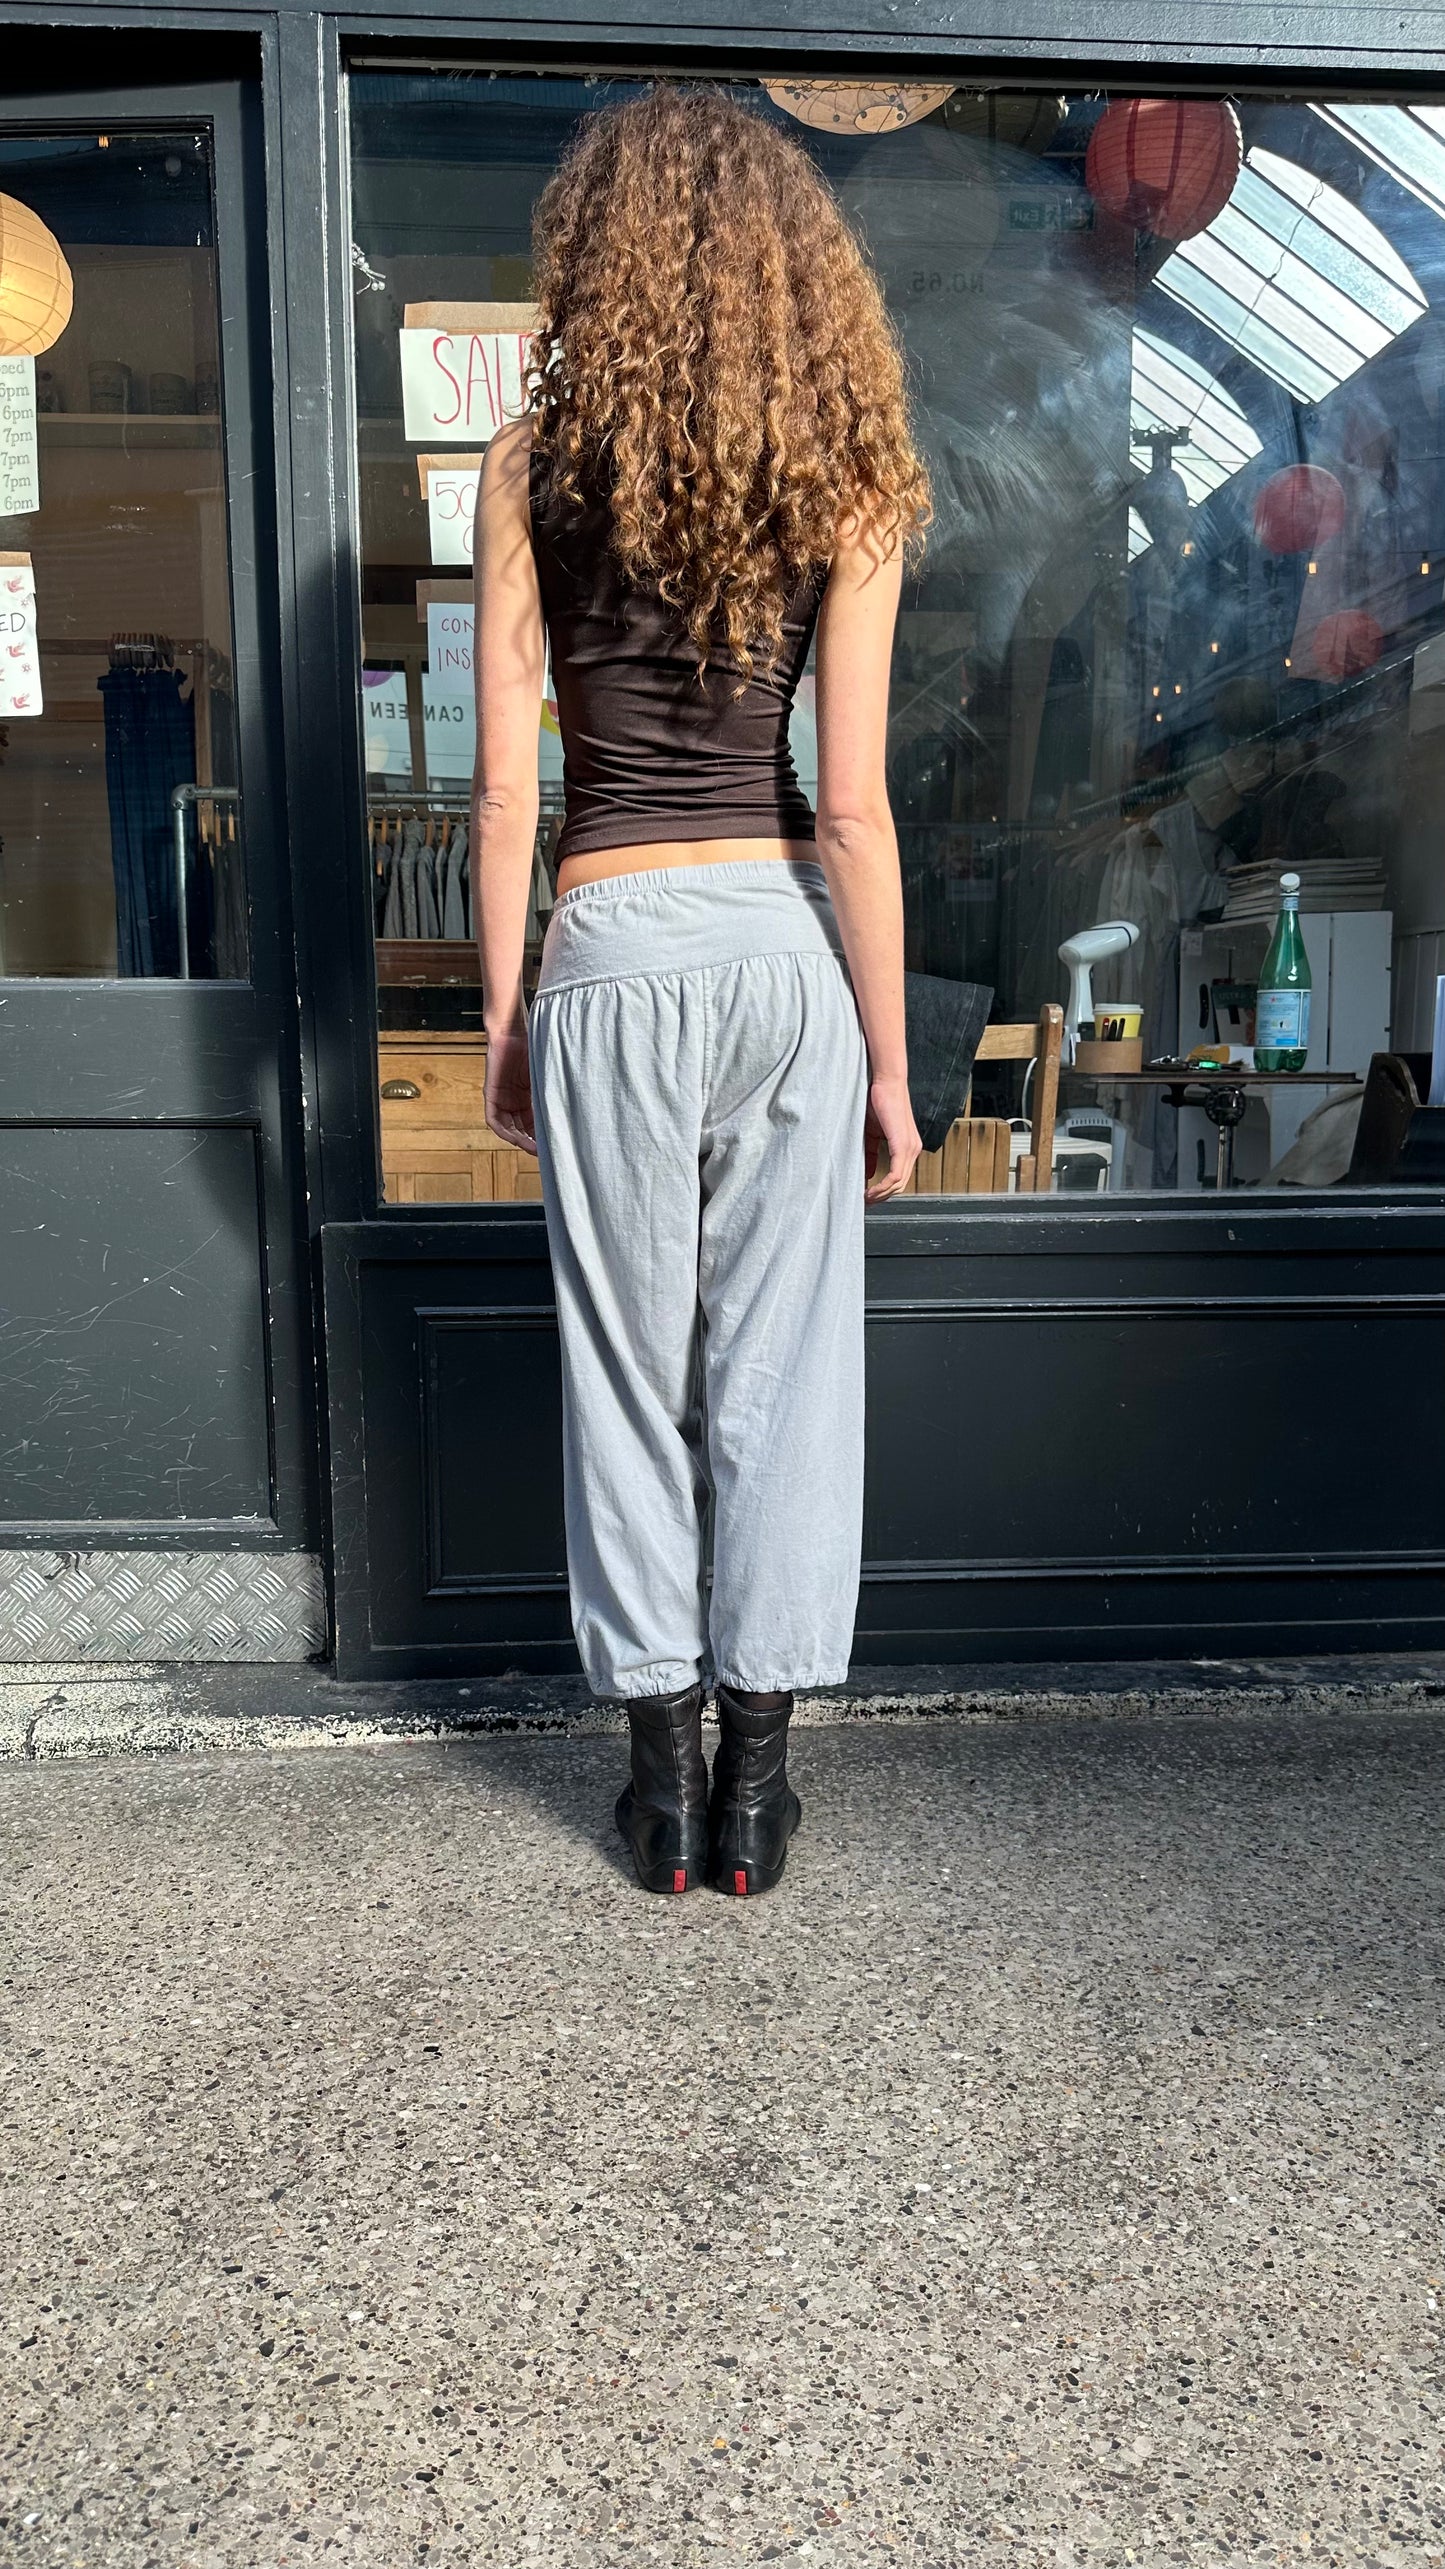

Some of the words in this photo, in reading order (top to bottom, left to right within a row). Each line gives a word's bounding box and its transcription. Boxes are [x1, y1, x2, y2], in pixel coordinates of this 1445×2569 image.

[2, 405, 33, 424] 6pm
[3, 428, 33, 447] 7pm
[1, 452, 30, 470] 7pm
[3, 474, 31, 493] 7pm
[4, 495, 33, 514] 6pm
